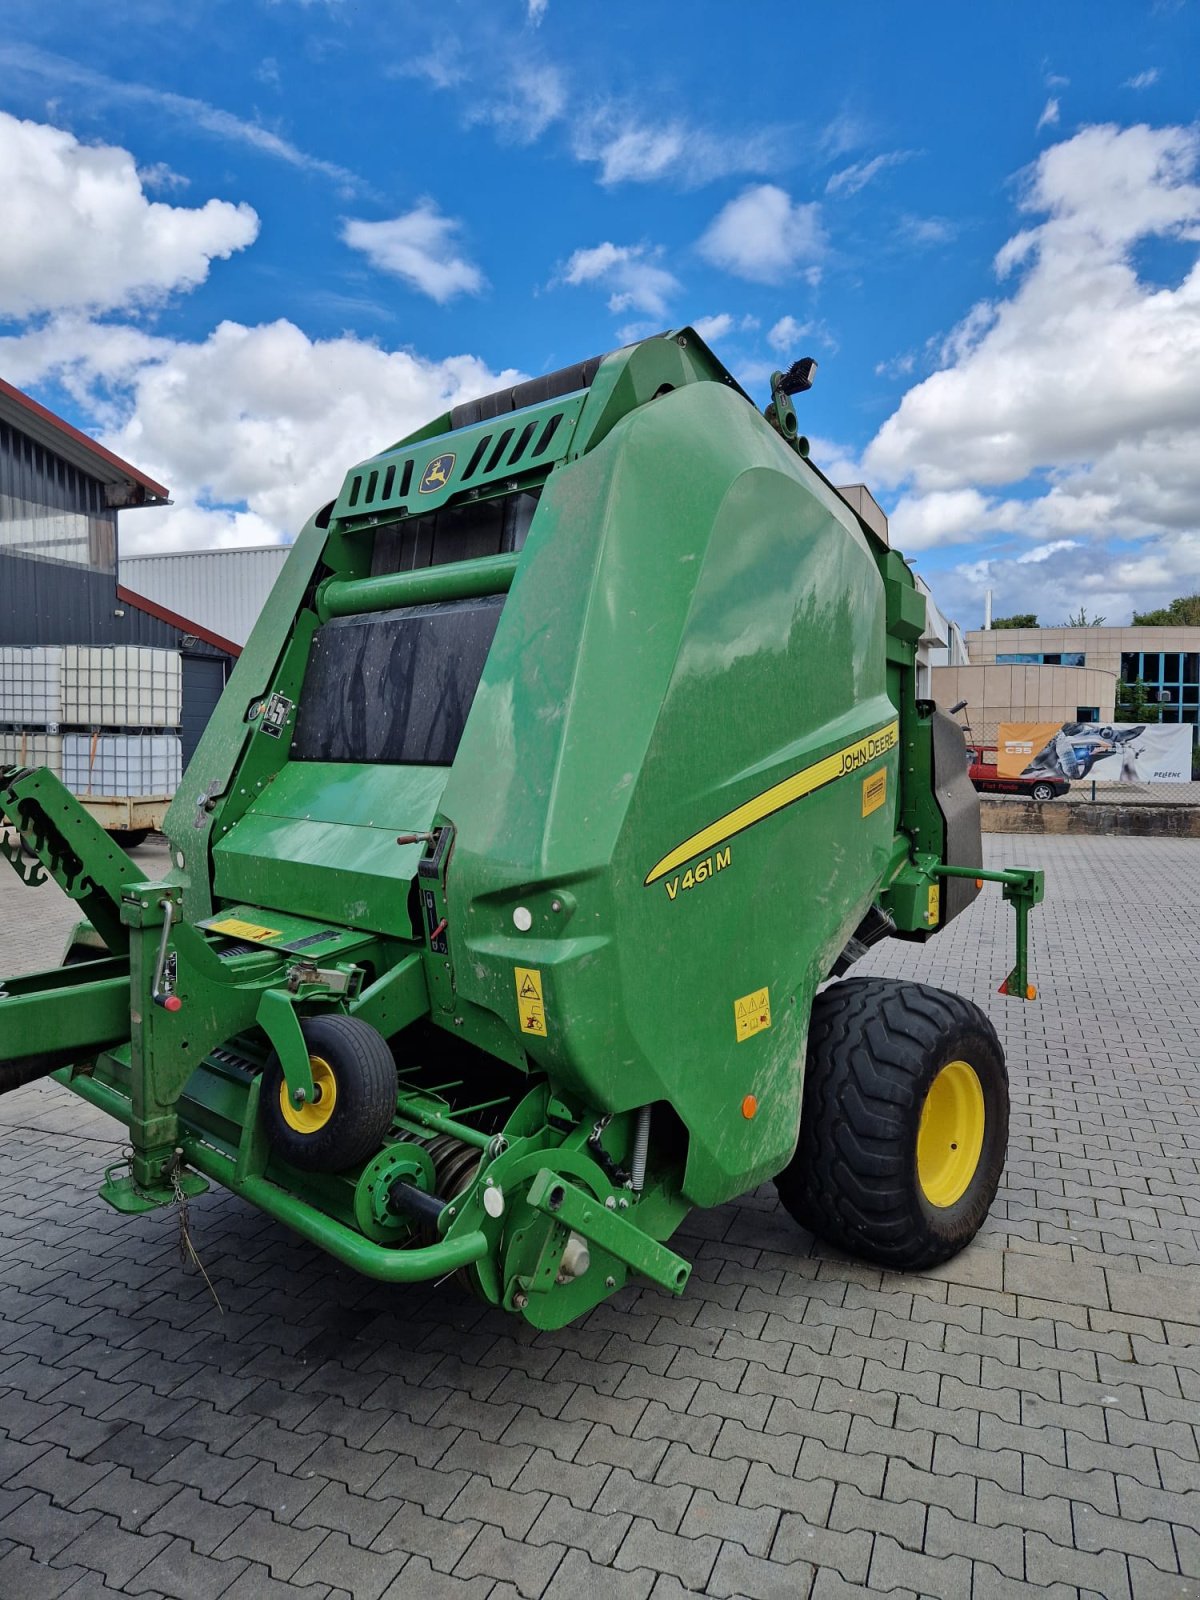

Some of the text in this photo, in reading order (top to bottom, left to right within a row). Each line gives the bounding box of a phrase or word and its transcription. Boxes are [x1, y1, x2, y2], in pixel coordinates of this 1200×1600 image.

[839, 731, 894, 776] JOHN DEERE
[664, 845, 731, 901] V 461 M
